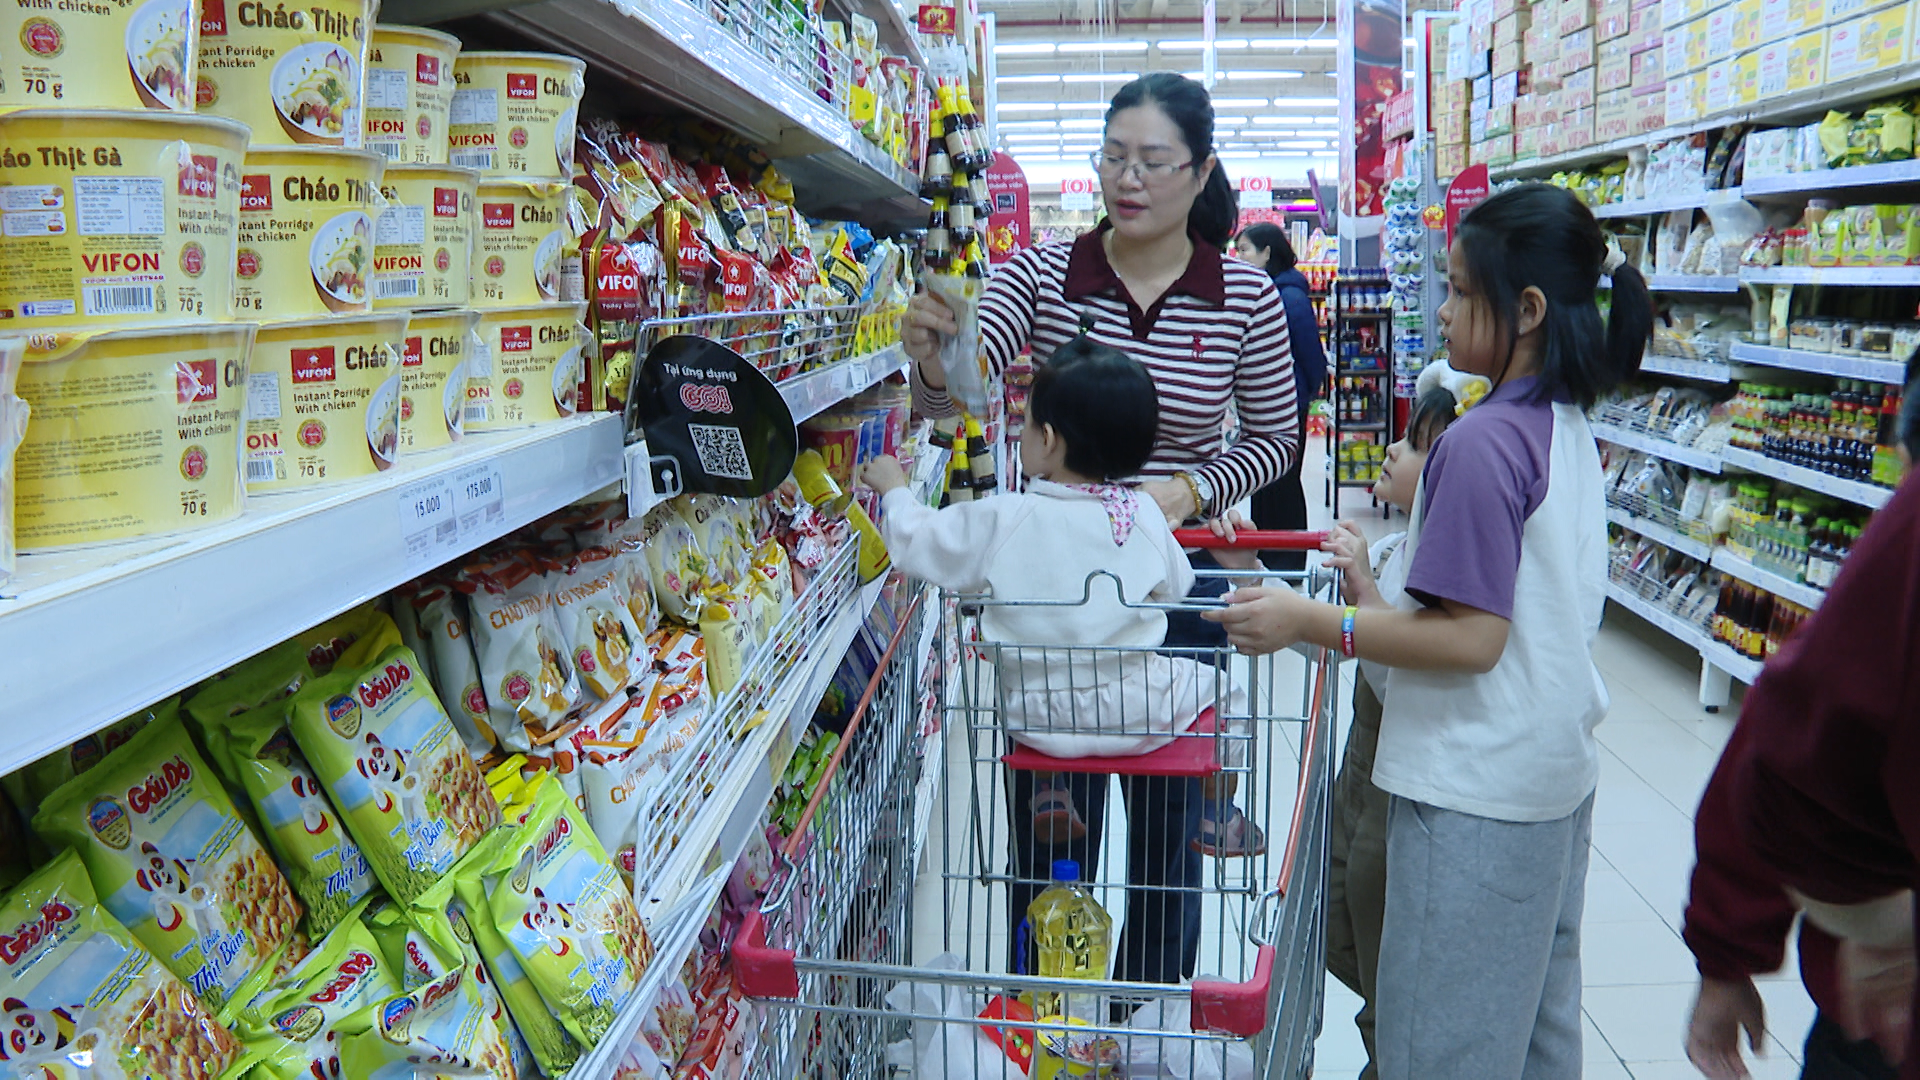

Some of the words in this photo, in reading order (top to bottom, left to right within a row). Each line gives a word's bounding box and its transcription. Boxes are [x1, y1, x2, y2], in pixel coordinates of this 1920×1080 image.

[58, 0, 111, 16] chicken
[238, 1, 304, 30] Cháo
[311, 7, 349, 41] Thịt
[225, 45, 275, 59] Porridge
[213, 58, 256, 68] chicken
[24, 79, 46, 94] 70
[53, 83, 64, 100] g
[510, 88, 535, 97] VIFON
[368, 120, 404, 133] IFON
[449, 133, 495, 146] VIFON
[37, 147, 87, 171] Thịt
[283, 176, 340, 202] Cháo
[242, 195, 267, 206] FON
[178, 207, 211, 221] Instant
[521, 205, 553, 224] Cháo
[179, 222, 202, 234] With
[270, 219, 314, 232] Porridge
[487, 218, 512, 226] VIFON
[257, 231, 297, 242] chicken
[82, 253, 160, 273] VIFON
[374, 255, 422, 270] VIFON
[484, 290, 496, 298] 70
[725, 283, 747, 295] IFON
[179, 297, 194, 312] 70
[539, 325, 570, 344] Cháo
[430, 335, 460, 357] Cháo
[505, 340, 530, 349] VIFON
[345, 344, 388, 370] Cháo
[297, 367, 332, 378] VIFON
[663, 362, 680, 377] Tại
[682, 365, 704, 380] ứng
[706, 367, 737, 382] dụng
[293, 391, 330, 402] Instant
[333, 387, 371, 399] Porridge
[295, 404, 319, 414] With
[323, 400, 357, 412] chicken
[177, 412, 213, 426] Instant
[504, 411, 515, 420] 70
[178, 427, 202, 440] With
[300, 465, 314, 477] 70
[319, 465, 326, 478] g
[466, 478, 492, 499] 175.000
[181, 501, 197, 515] 70
[200, 501, 208, 516] g
[415, 495, 441, 518] 15.000
[325, 866, 354, 897] Thịt
[187, 957, 224, 994] Thịt
